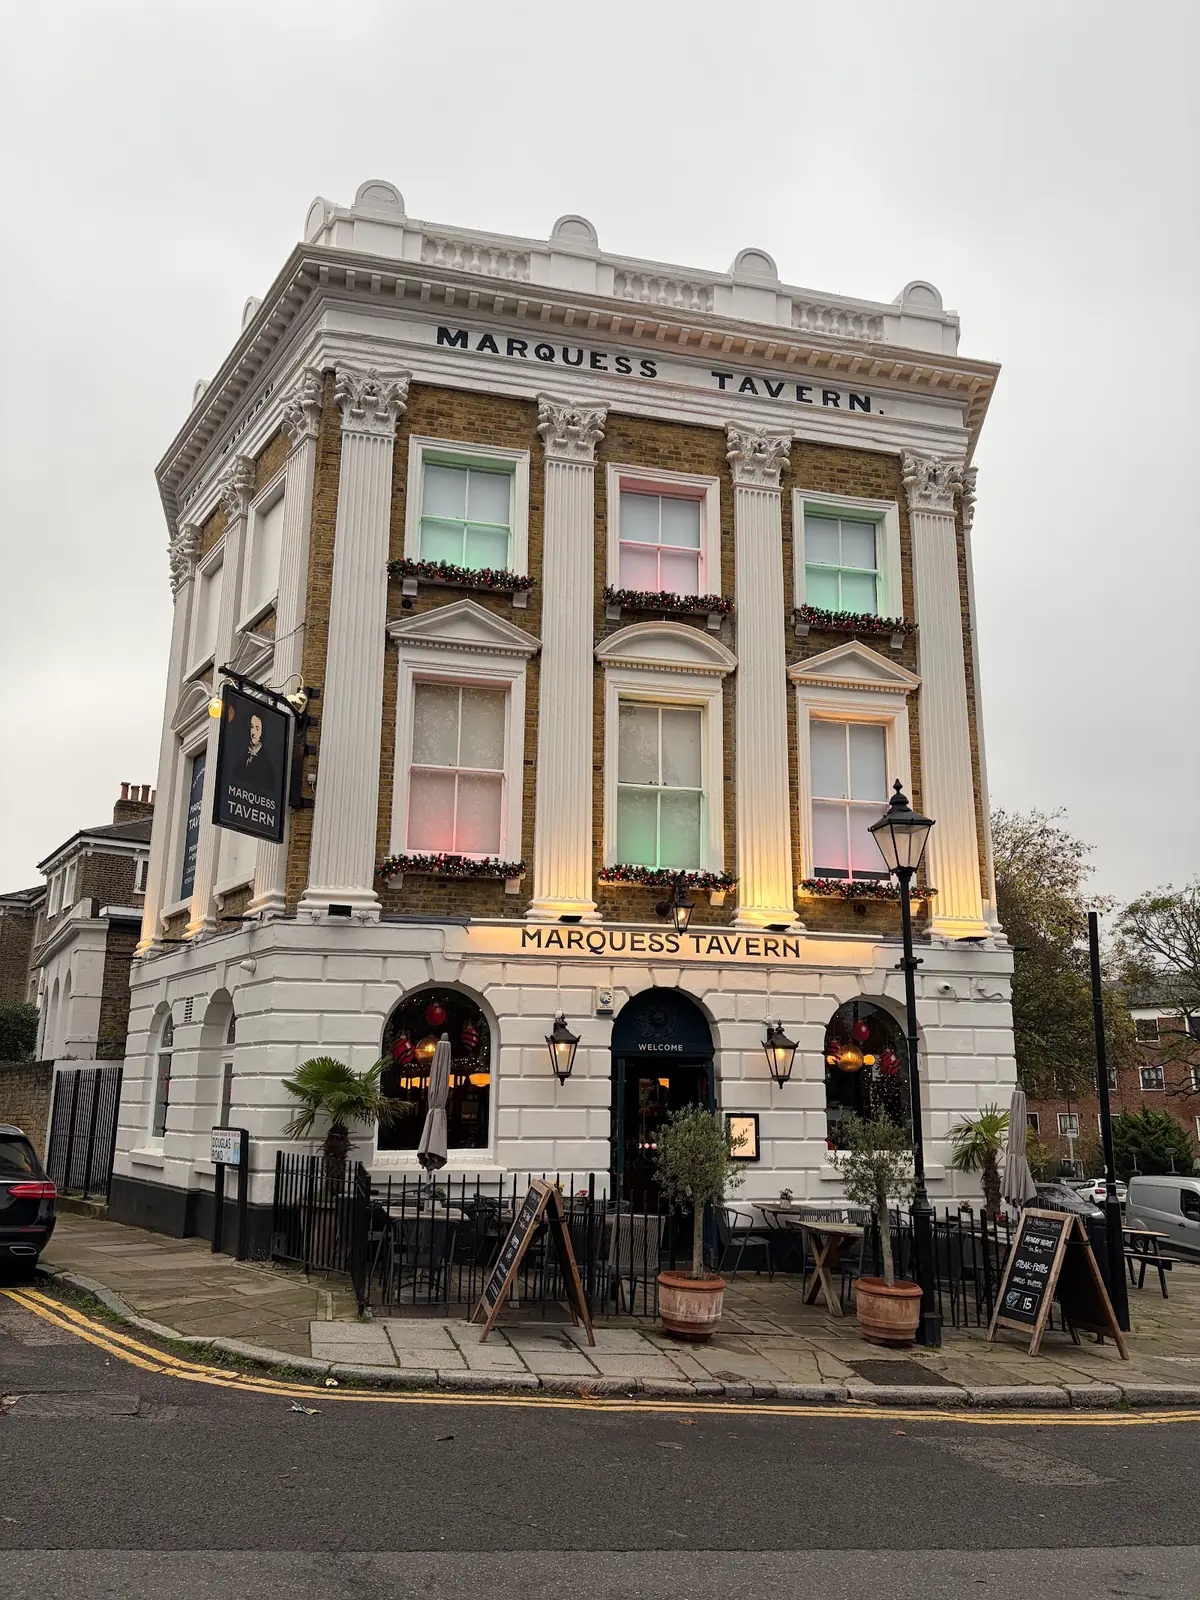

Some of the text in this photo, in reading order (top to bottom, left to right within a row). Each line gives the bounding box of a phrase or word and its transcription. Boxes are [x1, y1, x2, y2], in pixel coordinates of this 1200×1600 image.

[436, 326, 885, 416] MARQUESS TAVERN.
[228, 784, 276, 811] MARQUESS
[228, 800, 275, 828] TAVERN
[521, 928, 800, 958] MARQUESS TAVERN
[638, 1043, 683, 1052] WELCOME
[1022, 1296, 1033, 1310] 15
